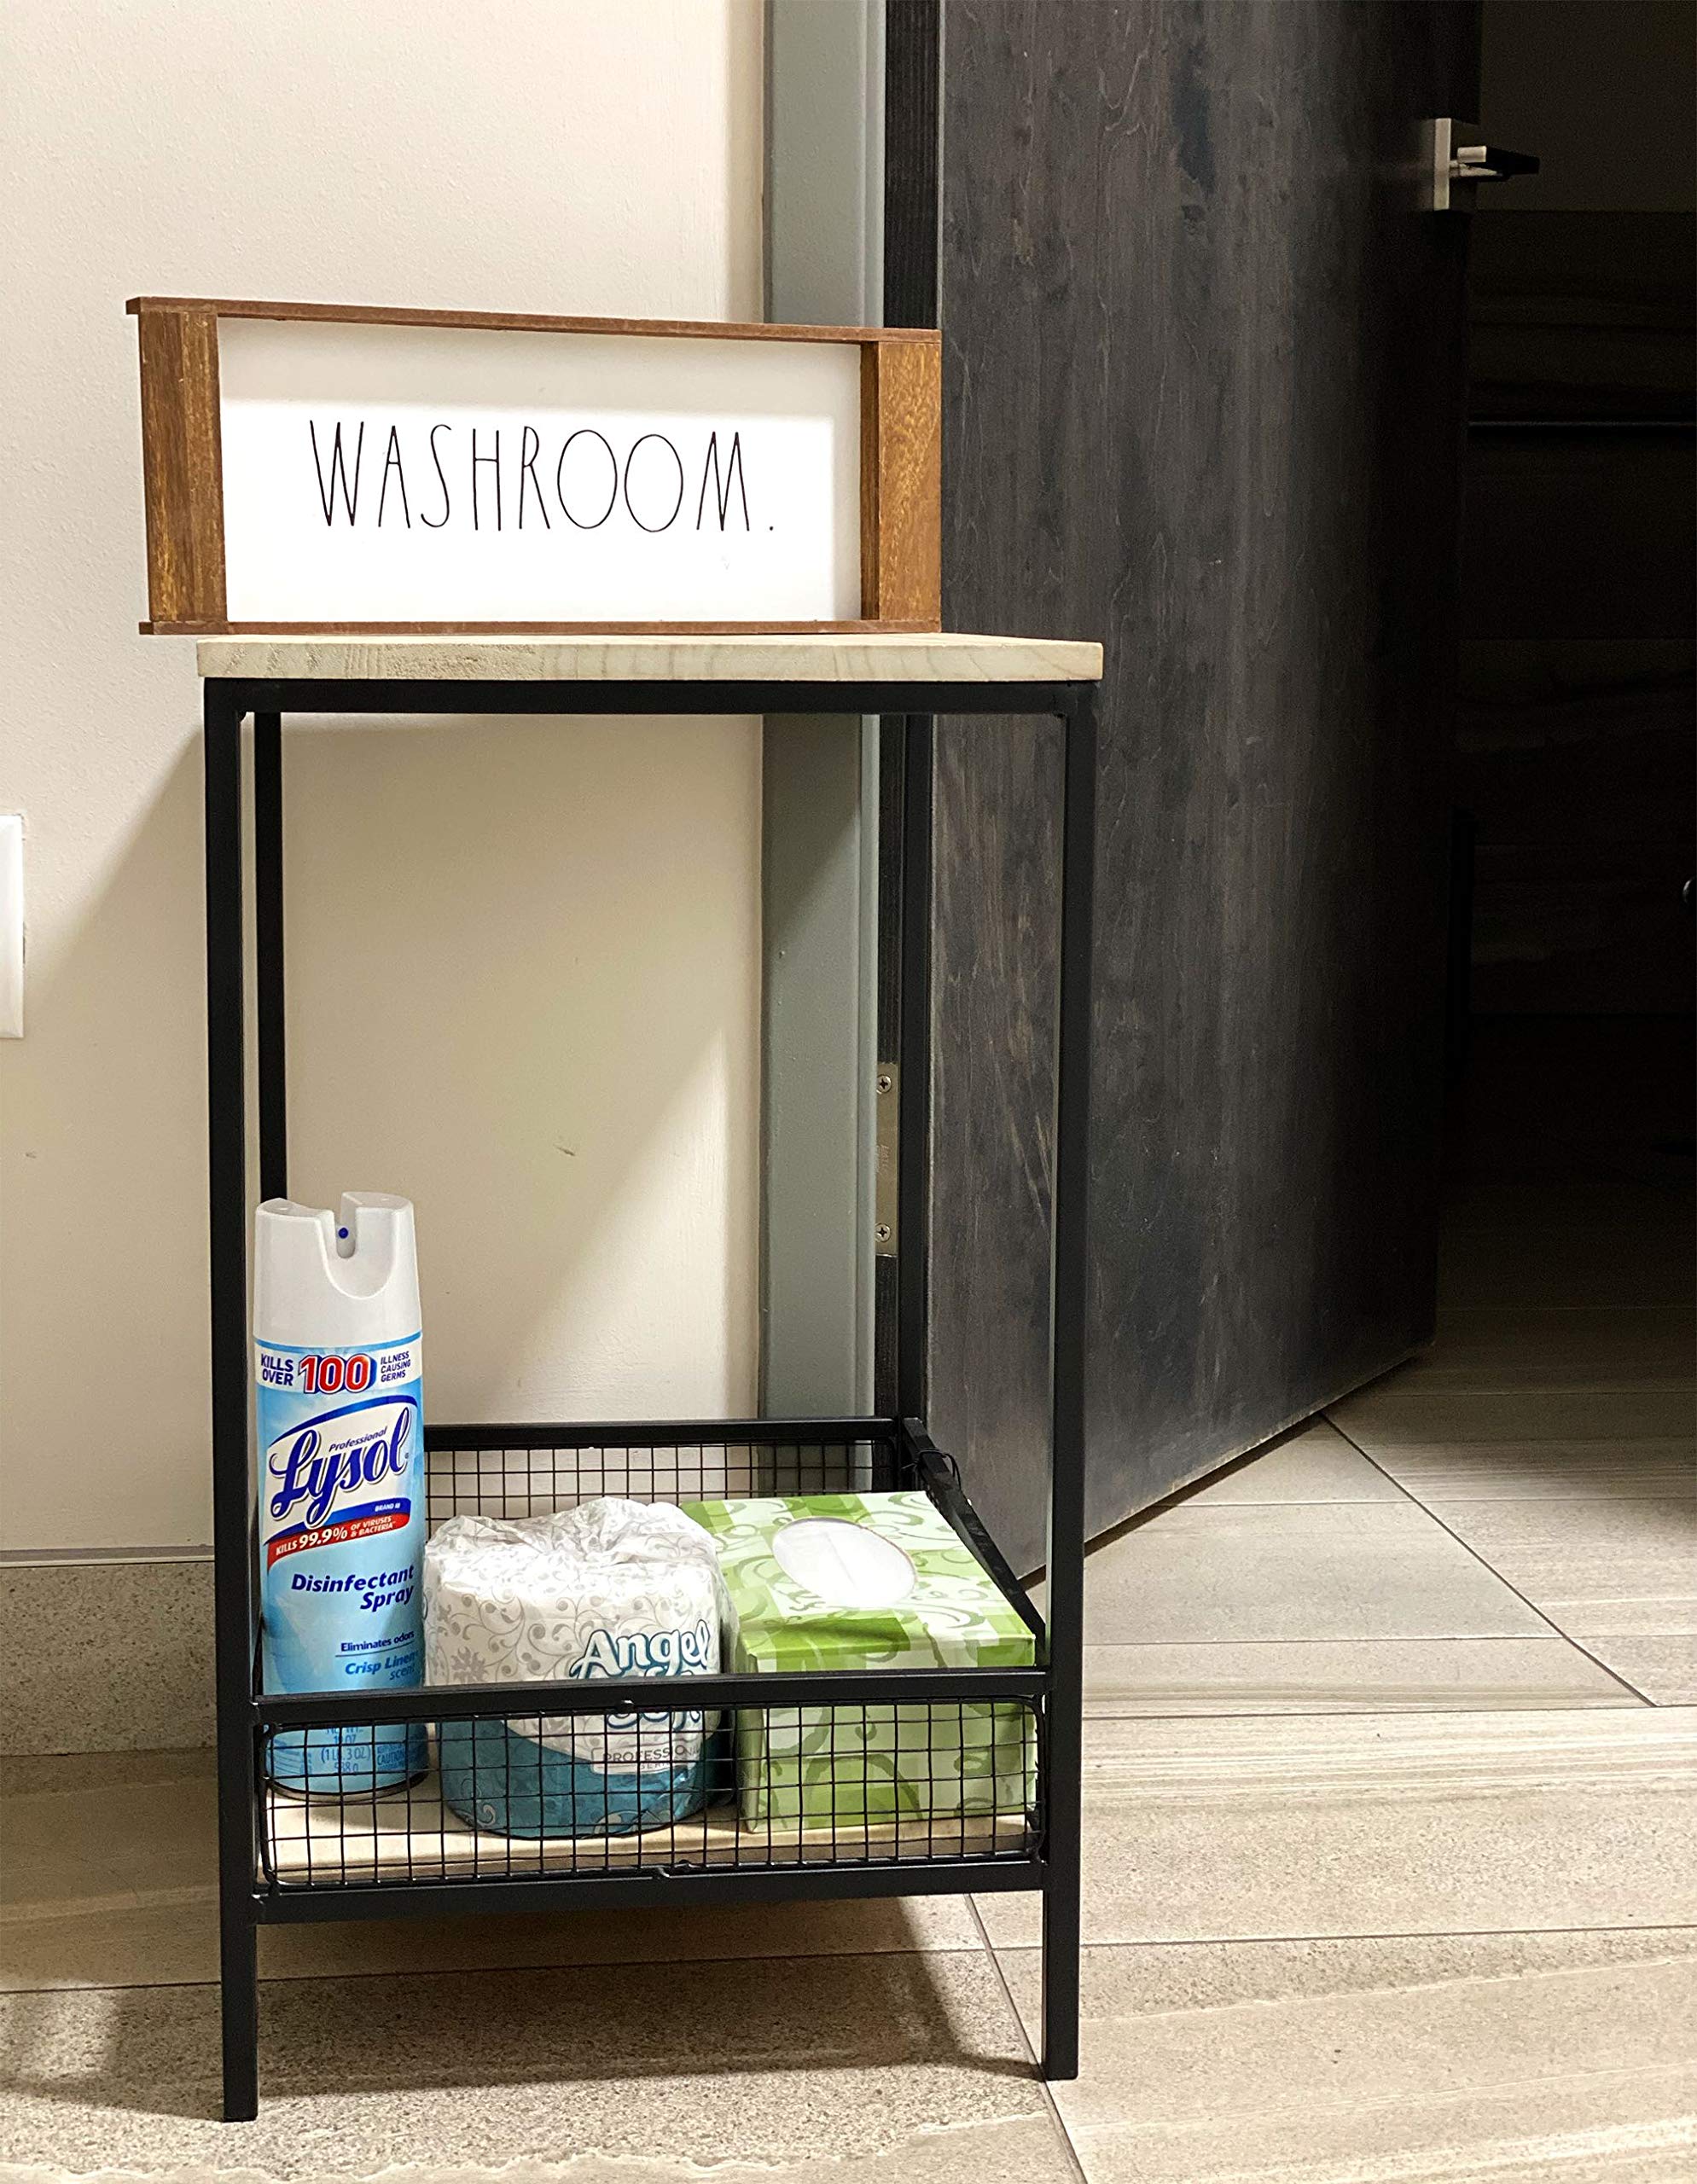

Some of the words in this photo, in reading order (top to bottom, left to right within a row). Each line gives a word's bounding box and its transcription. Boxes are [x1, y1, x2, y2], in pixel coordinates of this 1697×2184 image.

[310, 420, 775, 532] WASHROOM.
[260, 1353, 293, 1372] KILLS
[381, 1351, 410, 1365] ILLNESS
[381, 1359, 411, 1374] CAUSING
[262, 1368, 293, 1386] OVER
[299, 1354, 377, 1395] 100
[381, 1369, 406, 1382] GERMS
[329, 1426, 387, 1452] Professional
[269, 1407, 410, 1527] Lysol
[351, 1523, 362, 1531] OF
[363, 1515, 392, 1528] VIRUSES
[358, 1522, 393, 1536] BACTERIA
[276, 1539, 298, 1556] KILLS
[299, 1526, 348, 1549] 99.9%
[291, 1565, 415, 1593] Disinfectant
[360, 1585, 415, 1612] Spray
[340, 1638, 392, 1652] Eliminates
[393, 1630, 415, 1643] odors
[569, 1618, 711, 1680] Angel
[345, 1661, 381, 1676] Crisp
[385, 1651, 416, 1670] Linen
